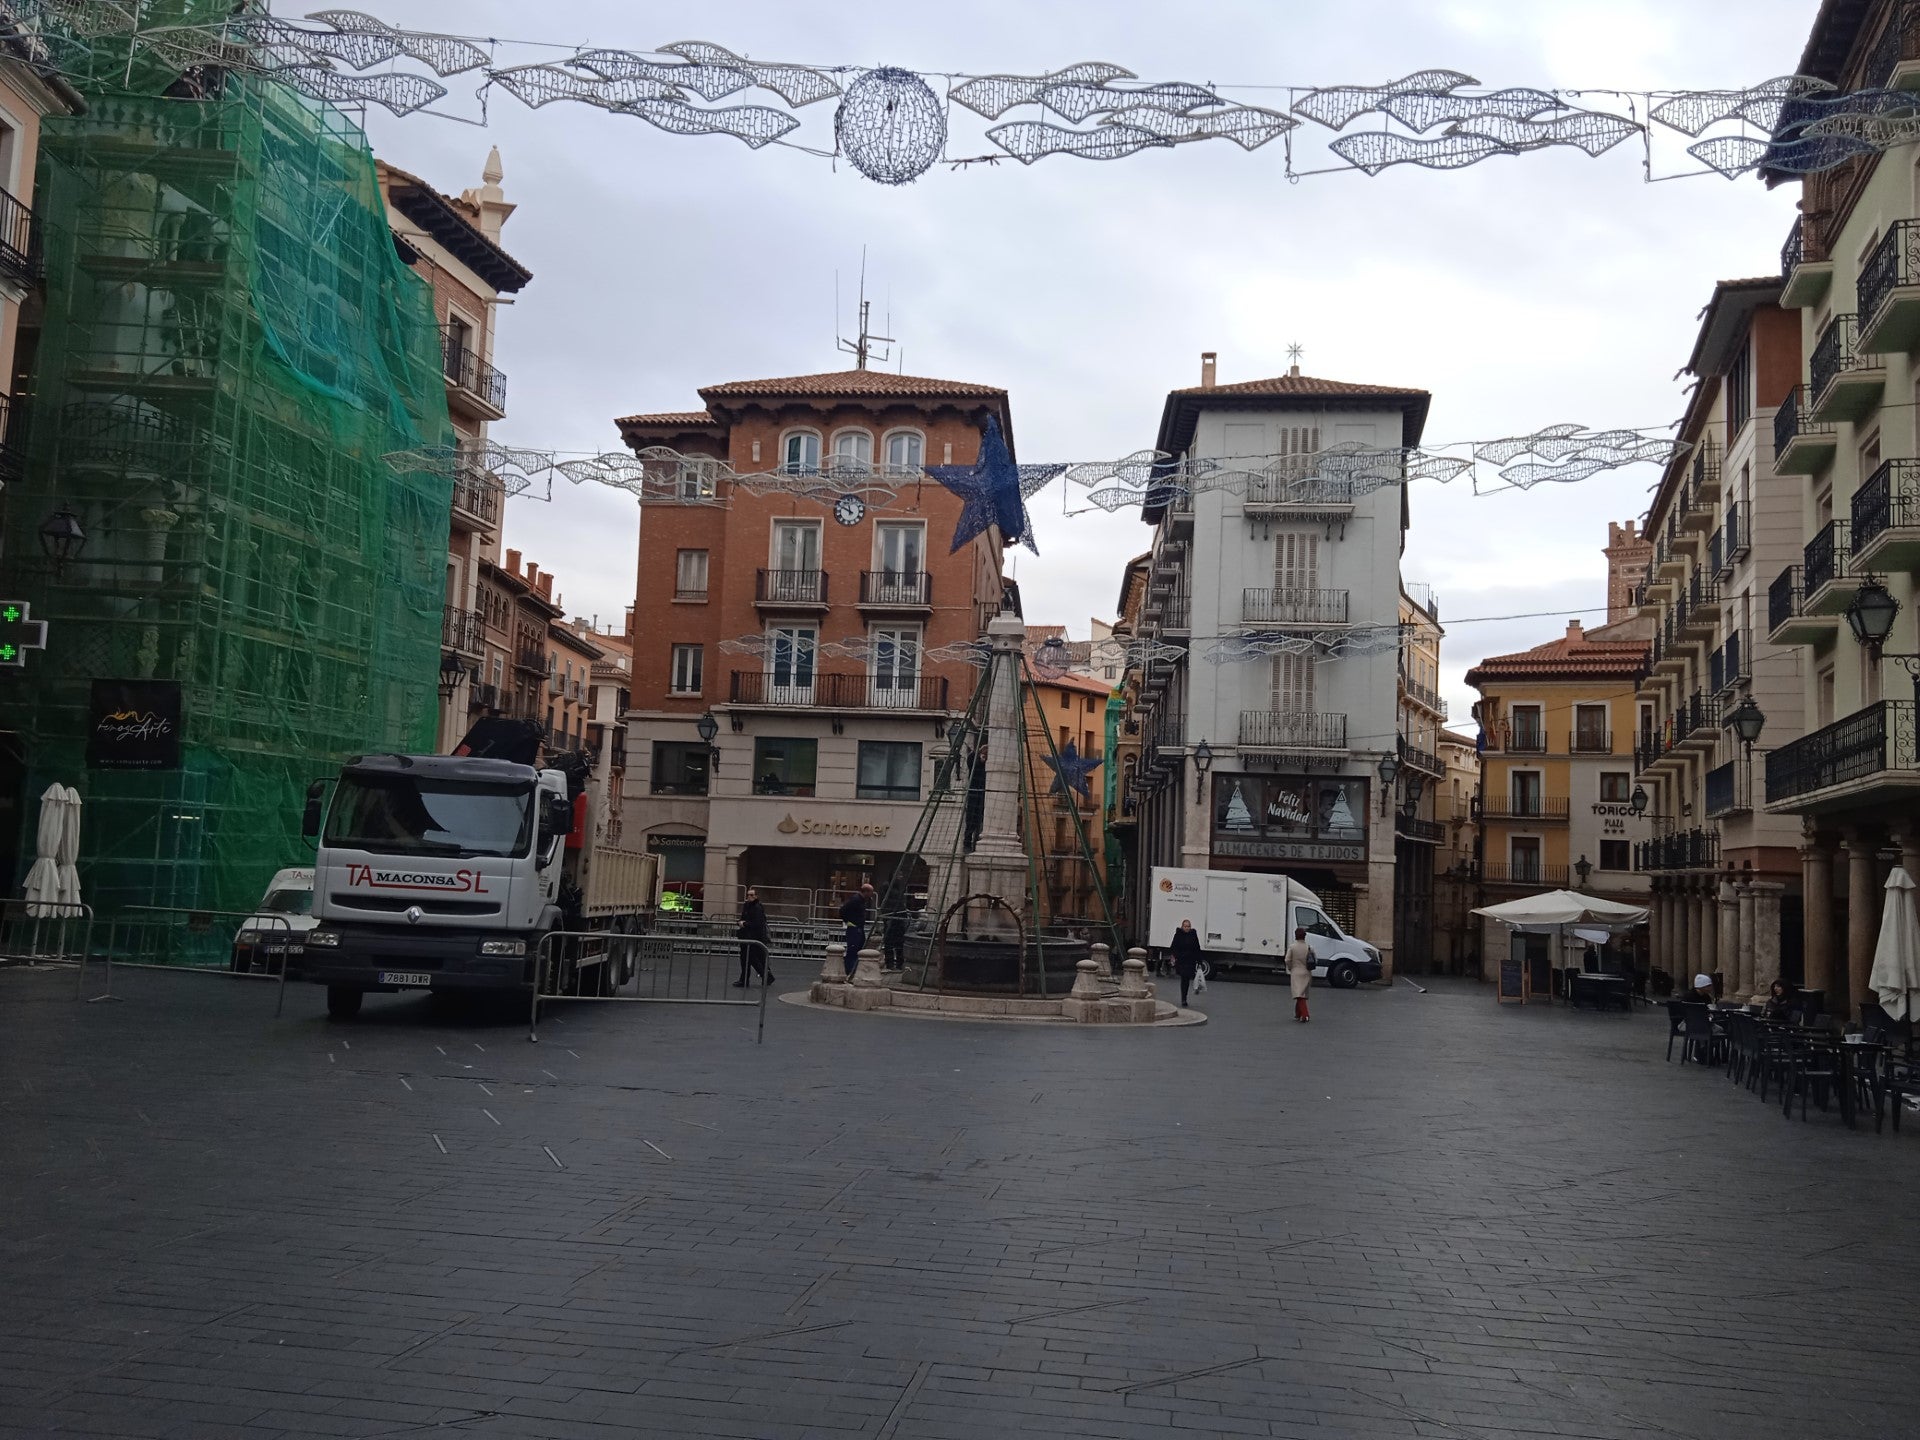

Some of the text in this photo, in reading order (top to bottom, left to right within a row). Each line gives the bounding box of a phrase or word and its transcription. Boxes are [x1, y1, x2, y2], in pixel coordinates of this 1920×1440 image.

[1278, 790, 1300, 808] Feliz
[1267, 803, 1311, 824] Navidad
[1591, 805, 1637, 816] TORICO
[801, 819, 890, 837] Santander
[1605, 819, 1624, 828] PLAZA
[660, 837, 704, 847] Santander
[1219, 843, 1360, 860] ALMACENES DE TEJIDOS
[388, 974, 409, 983] 7881
